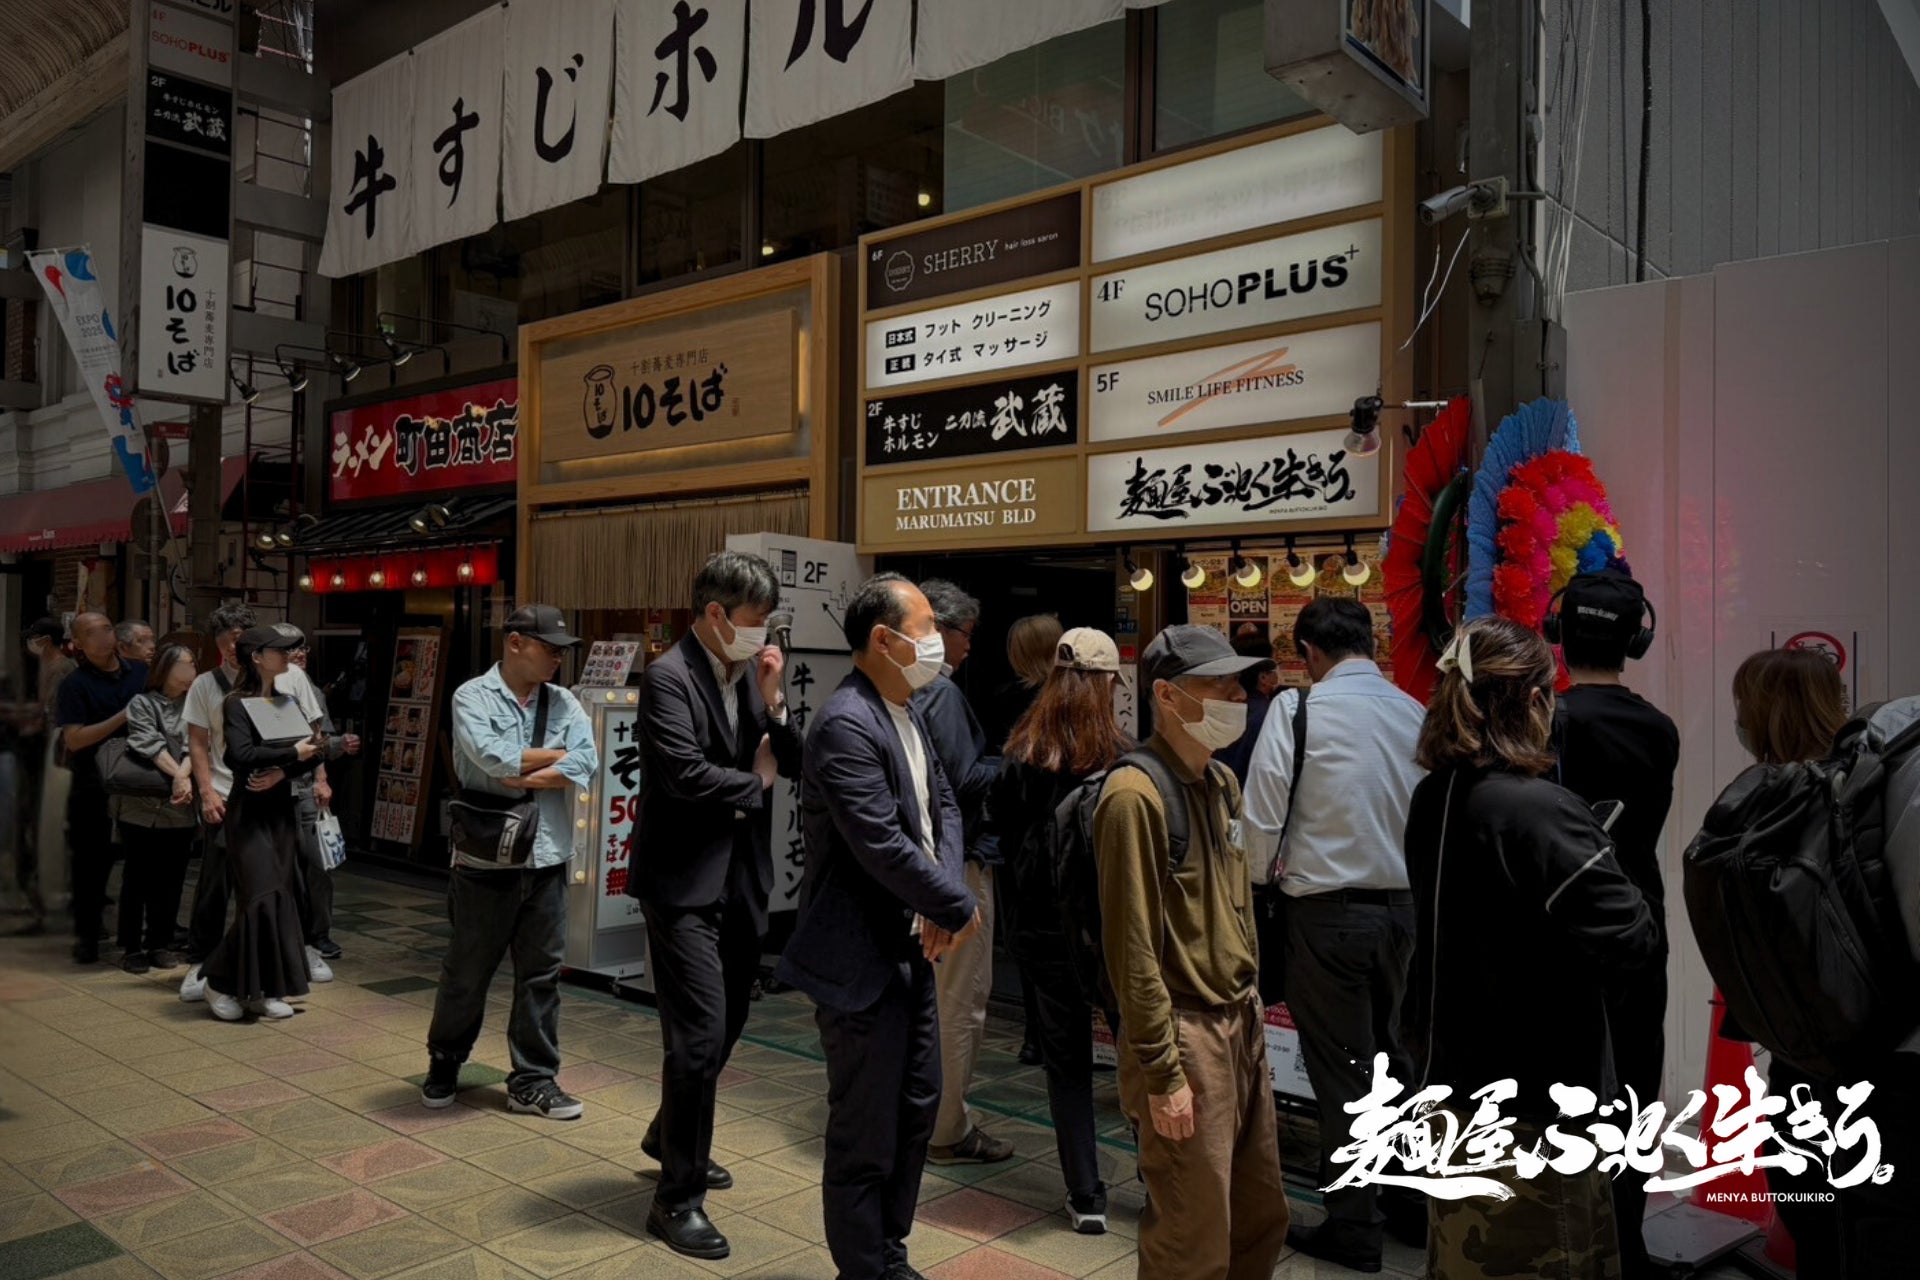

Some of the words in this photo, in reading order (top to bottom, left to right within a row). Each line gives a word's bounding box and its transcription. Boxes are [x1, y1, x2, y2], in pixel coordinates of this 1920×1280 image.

[151, 75, 167, 88] 2F
[871, 249, 884, 262] 6F
[923, 239, 999, 275] SHERRY
[1004, 242, 1019, 252] hair
[1097, 279, 1125, 303] 4F
[75, 313, 100, 327] EXPO
[81, 326, 104, 338] 2025
[165, 285, 201, 375] 10そば
[888, 330, 914, 345] 日本式
[925, 318, 961, 338] フット
[972, 300, 1051, 330] クリーニング
[924, 347, 962, 367] タイ式
[973, 331, 1048, 357] マッサージ
[1096, 371, 1120, 393] 5F
[1147, 385, 1194, 405] SMILE
[1197, 380, 1233, 399] LIFE
[1235, 370, 1304, 393] FITNESS
[623, 362, 728, 432] 10そば
[868, 402, 884, 418] 2F
[944, 411, 988, 431] 二刀流
[990, 383, 1068, 441] 武蔵
[883, 413, 923, 434] 牛すじ
[394, 398, 519, 476] 町田商店
[883, 431, 939, 453] ホルモン
[896, 477, 1037, 511] ENTRANCE
[896, 510, 995, 531] MARUMATSU
[1002, 507, 1037, 526] BLD
[804, 561, 828, 583] 2F
[1230, 600, 1267, 614] OPEN
